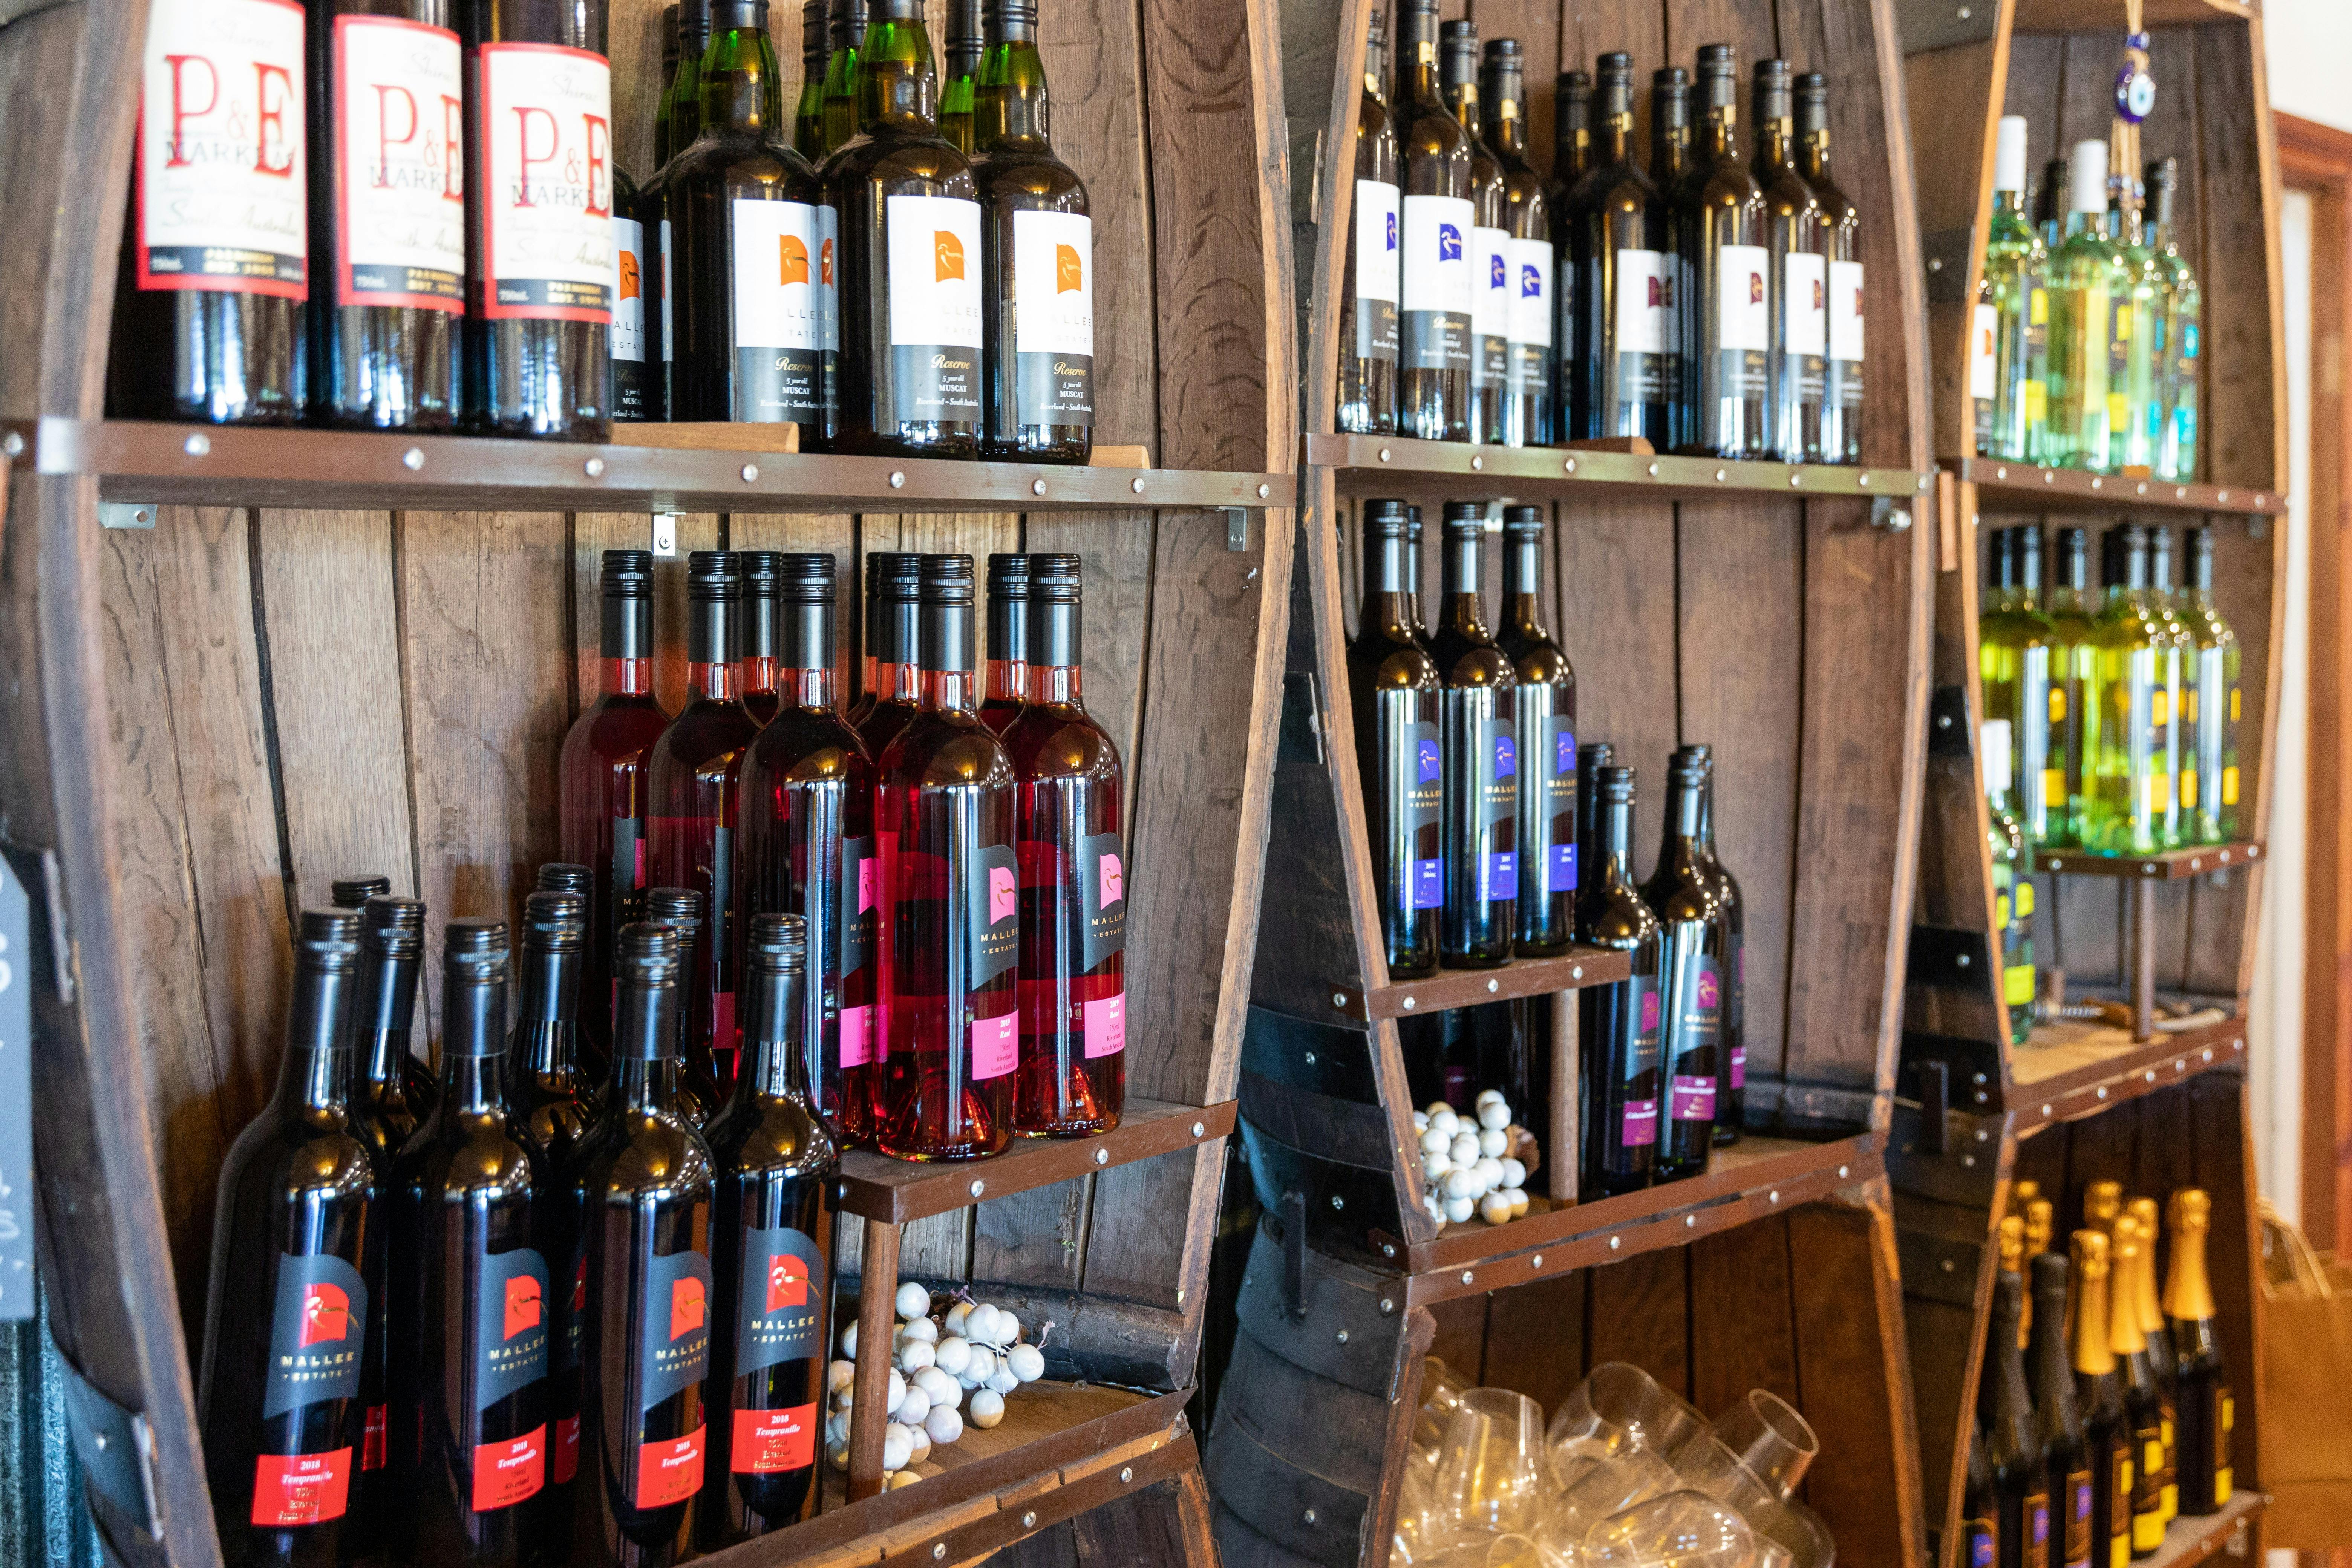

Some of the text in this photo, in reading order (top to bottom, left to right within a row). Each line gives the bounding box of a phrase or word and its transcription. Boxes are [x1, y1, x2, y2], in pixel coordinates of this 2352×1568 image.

[775, 357, 813, 372] Reserve
[930, 354, 971, 370] Reserve
[1054, 361, 1086, 376] Reserve
[781, 386, 811, 395] MUSCAT
[938, 384, 968, 392] MUSCAT
[1060, 390, 1084, 398] MUSCAT
[1040, 402, 1065, 410] Riverland
[1092, 911, 1124, 926] MALLEE
[980, 927, 1018, 942] MALLEE
[1099, 927, 1122, 937] ESTATE
[989, 943, 1015, 954] ESTATE
[1110, 999, 1119, 1008] 2019
[1109, 1009, 1120, 1019] Rosé
[1000, 1018, 1011, 1028] 2019
[1109, 1023, 1119, 1032] 750ml
[999, 1028, 1011, 1039] Rosé
[1107, 1031, 1121, 1042] Riverland
[1113, 1040, 1124, 1049] Australia
[996, 1052, 1012, 1062] Riverland
[751, 1315, 815, 1330] MALLEE
[761, 1332, 805, 1344] ESTATE
[489, 1335, 545, 1360] MALLEE
[655, 1336, 707, 1360] MALLEE
[280, 1351, 354, 1367] MALLEE
[771, 1414, 790, 1424] 2018
[756, 1424, 801, 1437] Tempranillo
[512, 1439, 528, 1454] 2018
[498, 1448, 537, 1469] Tempranillo
[300, 1459, 321, 1470] 2018
